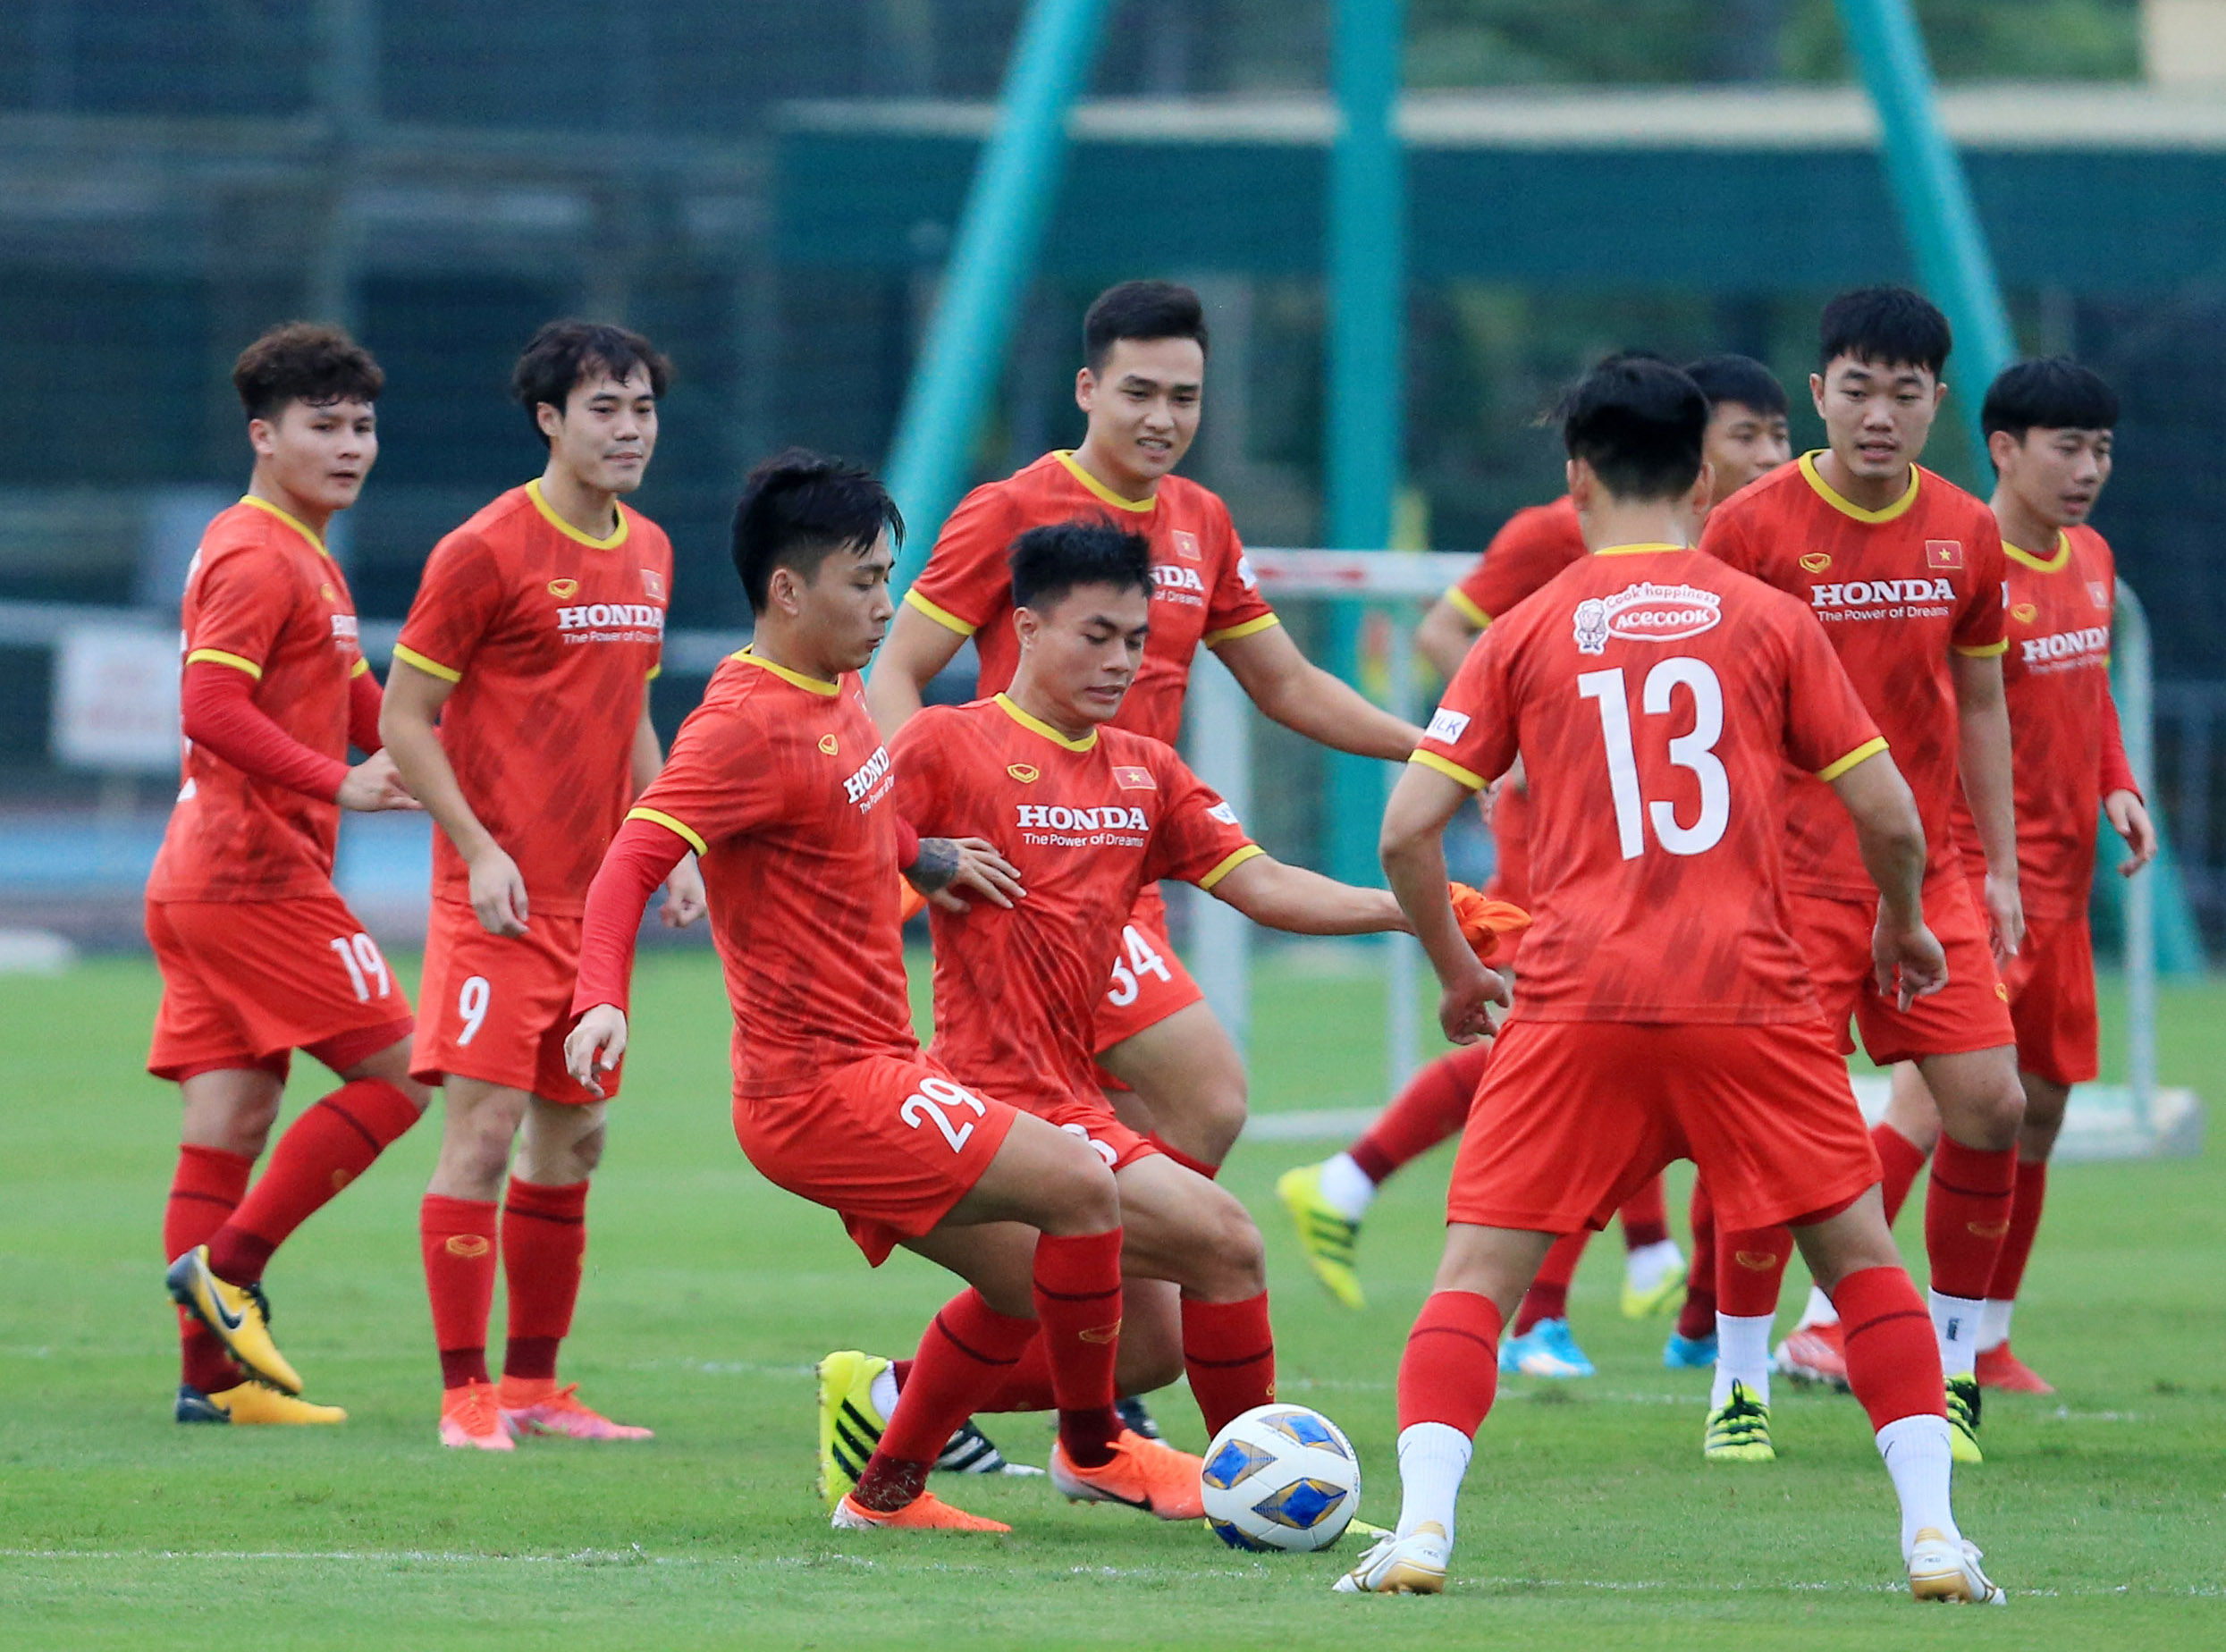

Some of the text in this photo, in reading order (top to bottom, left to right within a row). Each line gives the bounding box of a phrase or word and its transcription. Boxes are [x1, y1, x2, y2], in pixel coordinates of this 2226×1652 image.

[1606, 586, 1716, 608] Cook happiness
[1810, 578, 1956, 607] HONDA
[556, 604, 665, 629] HONDA
[1817, 606, 1949, 622] The Power of Dreams
[562, 633, 589, 644] The
[1578, 656, 1731, 860] 13
[1016, 805, 1150, 831] HONDA
[1023, 833, 1144, 847] The Power of Dreams
[331, 932, 391, 1002] 19
[457, 975, 491, 1045] 9
[900, 1077, 986, 1153] 29
